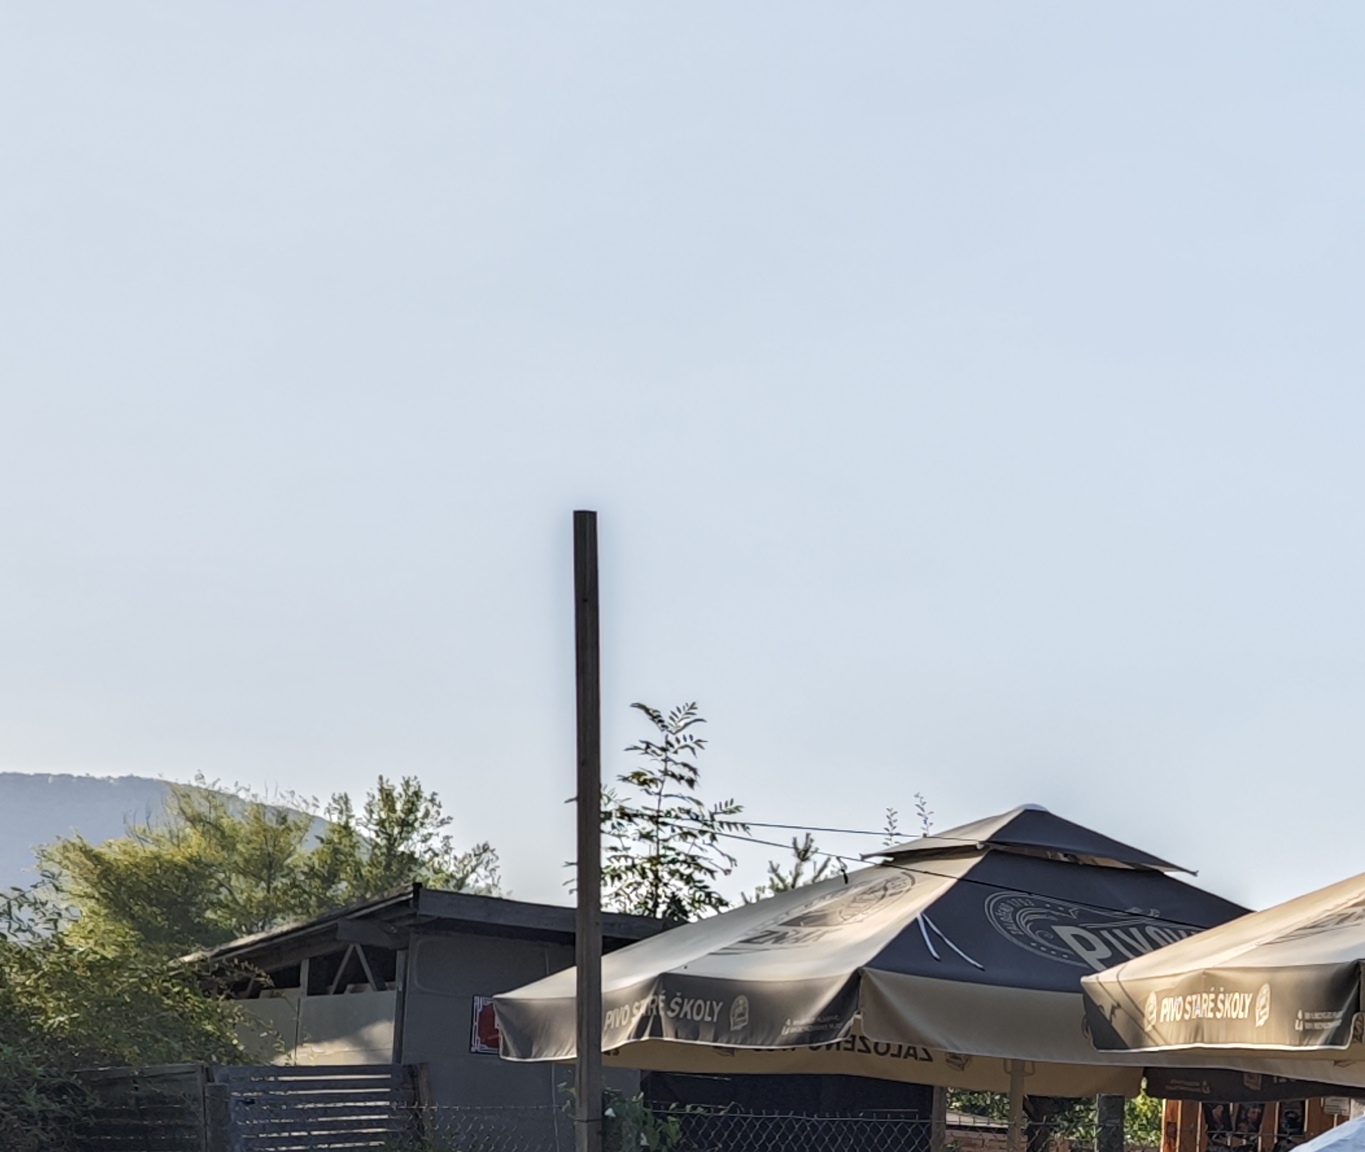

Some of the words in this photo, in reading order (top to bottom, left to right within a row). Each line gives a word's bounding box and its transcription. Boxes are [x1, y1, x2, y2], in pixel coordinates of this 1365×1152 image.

[604, 1004, 630, 1031] PIVO
[667, 992, 724, 1023] ŠKOLY
[1160, 996, 1184, 1023] PIVO
[1184, 987, 1214, 1020] STARÉ
[1215, 987, 1253, 1020] ŠKOLY
